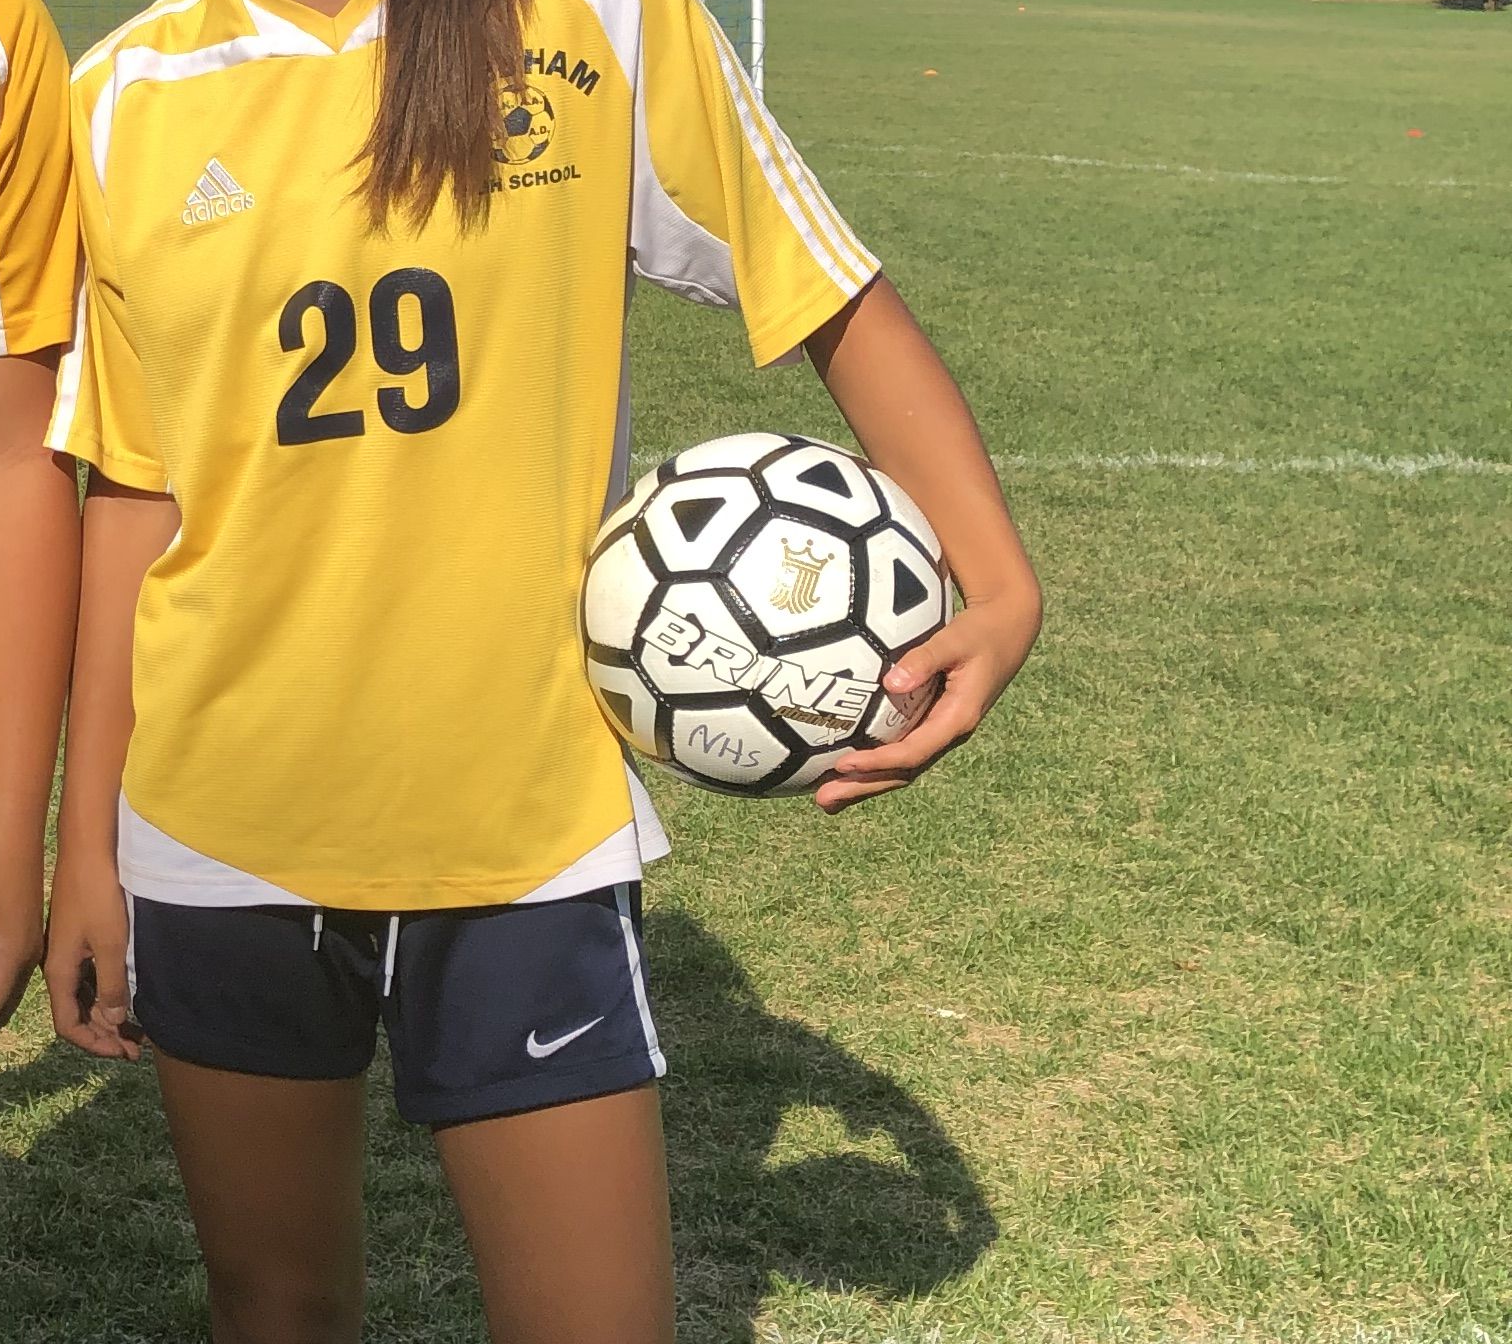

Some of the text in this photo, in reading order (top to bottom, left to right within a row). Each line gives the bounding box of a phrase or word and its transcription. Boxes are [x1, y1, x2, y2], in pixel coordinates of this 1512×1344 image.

[509, 164, 582, 191] SCHOOL
[181, 192, 256, 226] adidas
[276, 267, 461, 447] 29
[640, 605, 880, 720] BRINE
[771, 706, 857, 731] phantom
[688, 723, 762, 768] NHS
